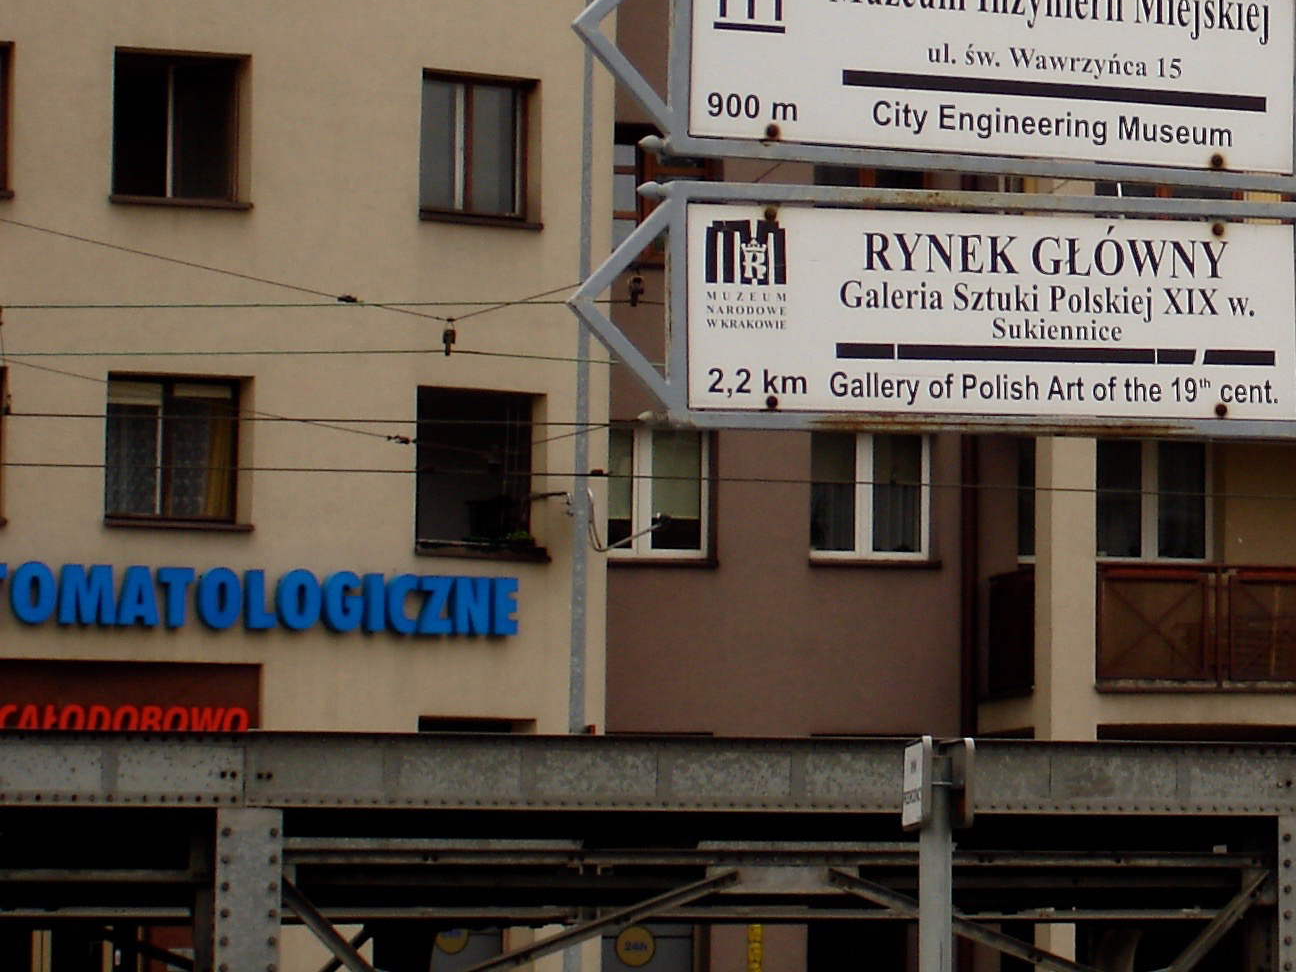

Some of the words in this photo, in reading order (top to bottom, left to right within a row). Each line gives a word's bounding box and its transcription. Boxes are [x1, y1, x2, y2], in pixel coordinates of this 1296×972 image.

[929, 43, 956, 64] ul.
[966, 44, 1000, 67] św.
[1010, 48, 1146, 79] Wawrzyńca
[1159, 58, 1181, 78] 15
[708, 93, 759, 118] 900
[772, 103, 797, 121] m
[873, 101, 927, 134] City
[940, 105, 1106, 145] Engineering
[1119, 116, 1232, 147] Museum
[863, 233, 1018, 274] RYNEK
[1032, 226, 1228, 278] GŁÓWNY
[706, 291, 787, 302] MUZEUM
[706, 305, 787, 316] NARODOWE
[840, 281, 942, 309] Galeria
[954, 283, 1038, 311] Sztuki
[1050, 286, 1151, 319] Polskiej
[1164, 288, 1217, 315] XIX
[1228, 298, 1254, 316] w.
[706, 318, 717, 328] W
[720, 319, 787, 330] KRAKOWIE
[993, 318, 1121, 341] Sukiennice
[709, 368, 751, 398] 2,2
[764, 369, 806, 394] km
[830, 372, 919, 404] Gallery
[929, 373, 953, 398] of
[963, 374, 1038, 400] Polish
[1048, 376, 1084, 401] Art
[1093, 377, 1116, 401] of
[1124, 377, 1161, 402] the
[1221, 380, 1277, 403] cent.
[0, 561, 519, 636] OMATOLOGICZNE
